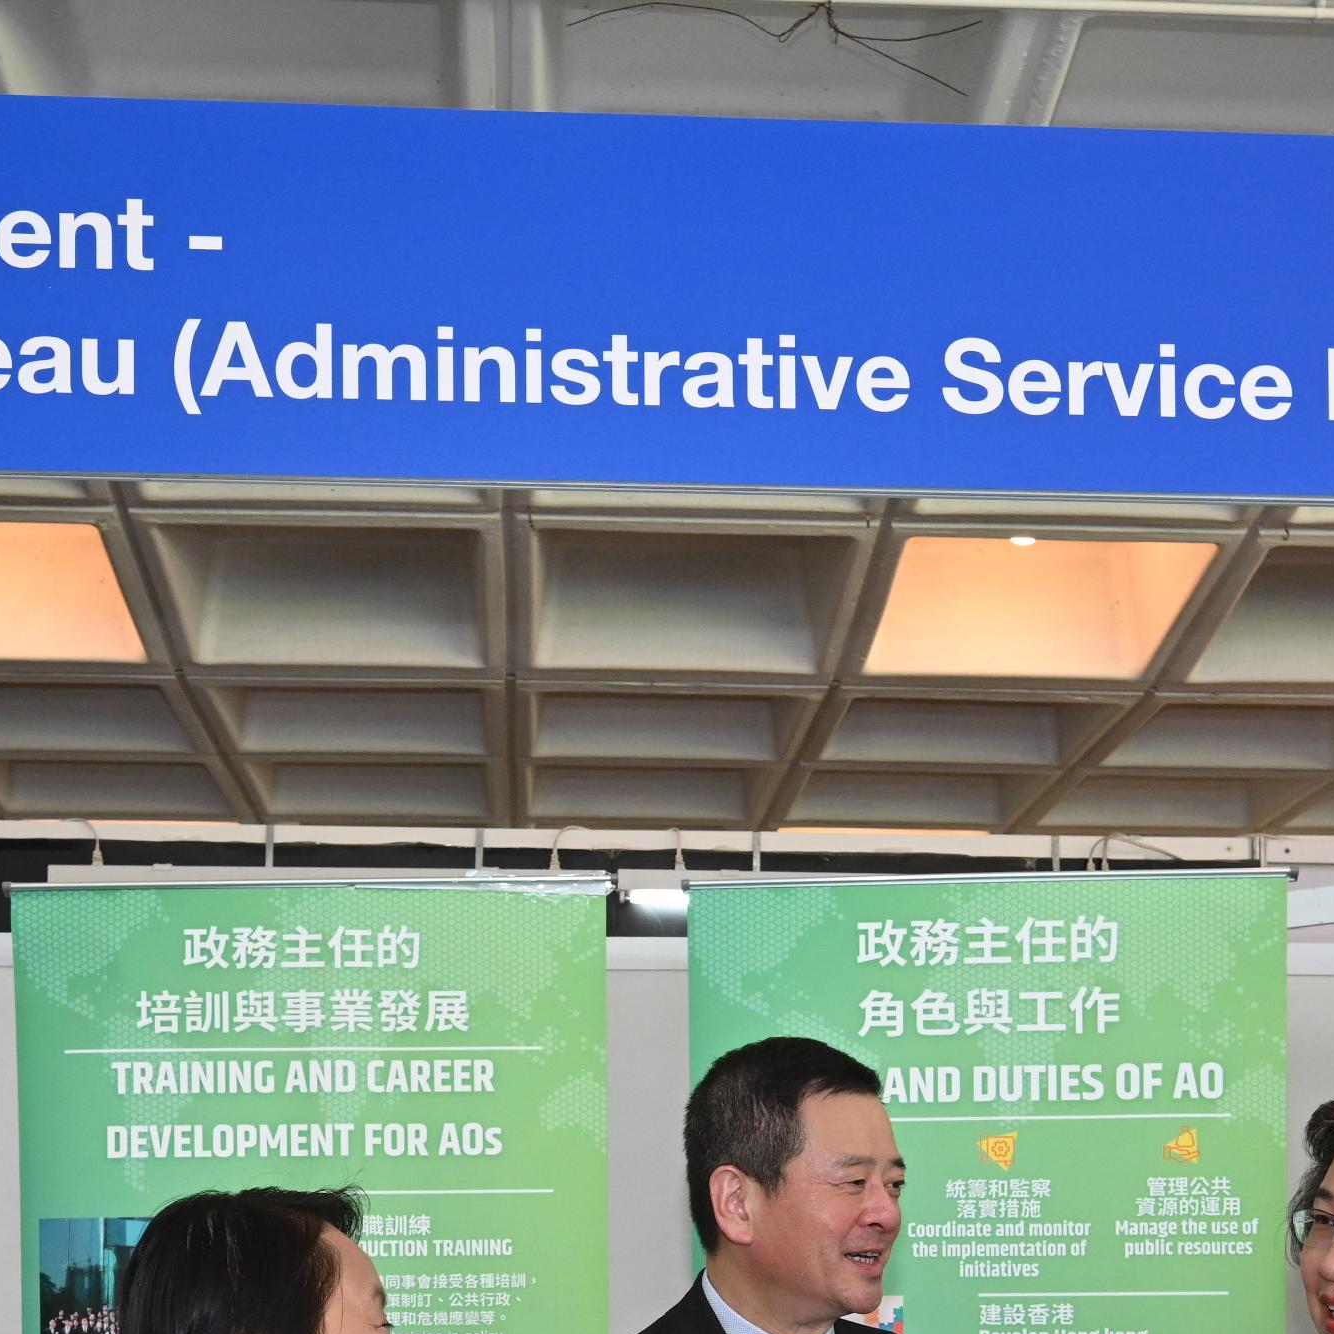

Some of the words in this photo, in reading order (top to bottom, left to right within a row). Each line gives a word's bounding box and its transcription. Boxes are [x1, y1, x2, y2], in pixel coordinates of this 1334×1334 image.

[171, 319, 910, 417] (Administrative
[942, 337, 1292, 421] Service
[182, 927, 420, 969] 政務主任的
[856, 916, 1119, 966] 政務主任的
[136, 991, 468, 1034] 培訓與事業發展
[858, 987, 1120, 1036] 角色與工作
[112, 1061, 274, 1094] TRAINING
[285, 1060, 355, 1092] AND
[367, 1059, 494, 1092] CAREER
[883, 1067, 960, 1103] AND
[973, 1065, 1104, 1102] DUTIES
[1116, 1063, 1162, 1101] OF
[1173, 1062, 1224, 1099] AO
[106, 1124, 354, 1158] DEVELOPMENT
[365, 1123, 428, 1156] FOR
[438, 1122, 502, 1155] AOs
[946, 1178, 1051, 1198] 統籌和監察
[1147, 1176, 1231, 1196] 管理公共
[957, 1199, 1041, 1218] 落實措施
[1135, 1196, 1241, 1216] 資源的運用
[907, 1222, 991, 1238] Coordinate
[996, 1222, 1024, 1237] and
[1029, 1220, 1091, 1236] monitor
[1115, 1221, 1177, 1238] Manage
[1182, 1219, 1207, 1235] the
[1211, 1221, 1238, 1234] use
[1242, 1218, 1259, 1234] of
[433, 1239, 512, 1256] TRAINING
[912, 1241, 938, 1257] the
[942, 1240, 1066, 1259] implementation
[1070, 1240, 1086, 1256] of
[1124, 1239, 1172, 1258] public
[1177, 1240, 1252, 1255] resources
[960, 1260, 1039, 1278] initiatives
[979, 1303, 1074, 1326] 建設香港
